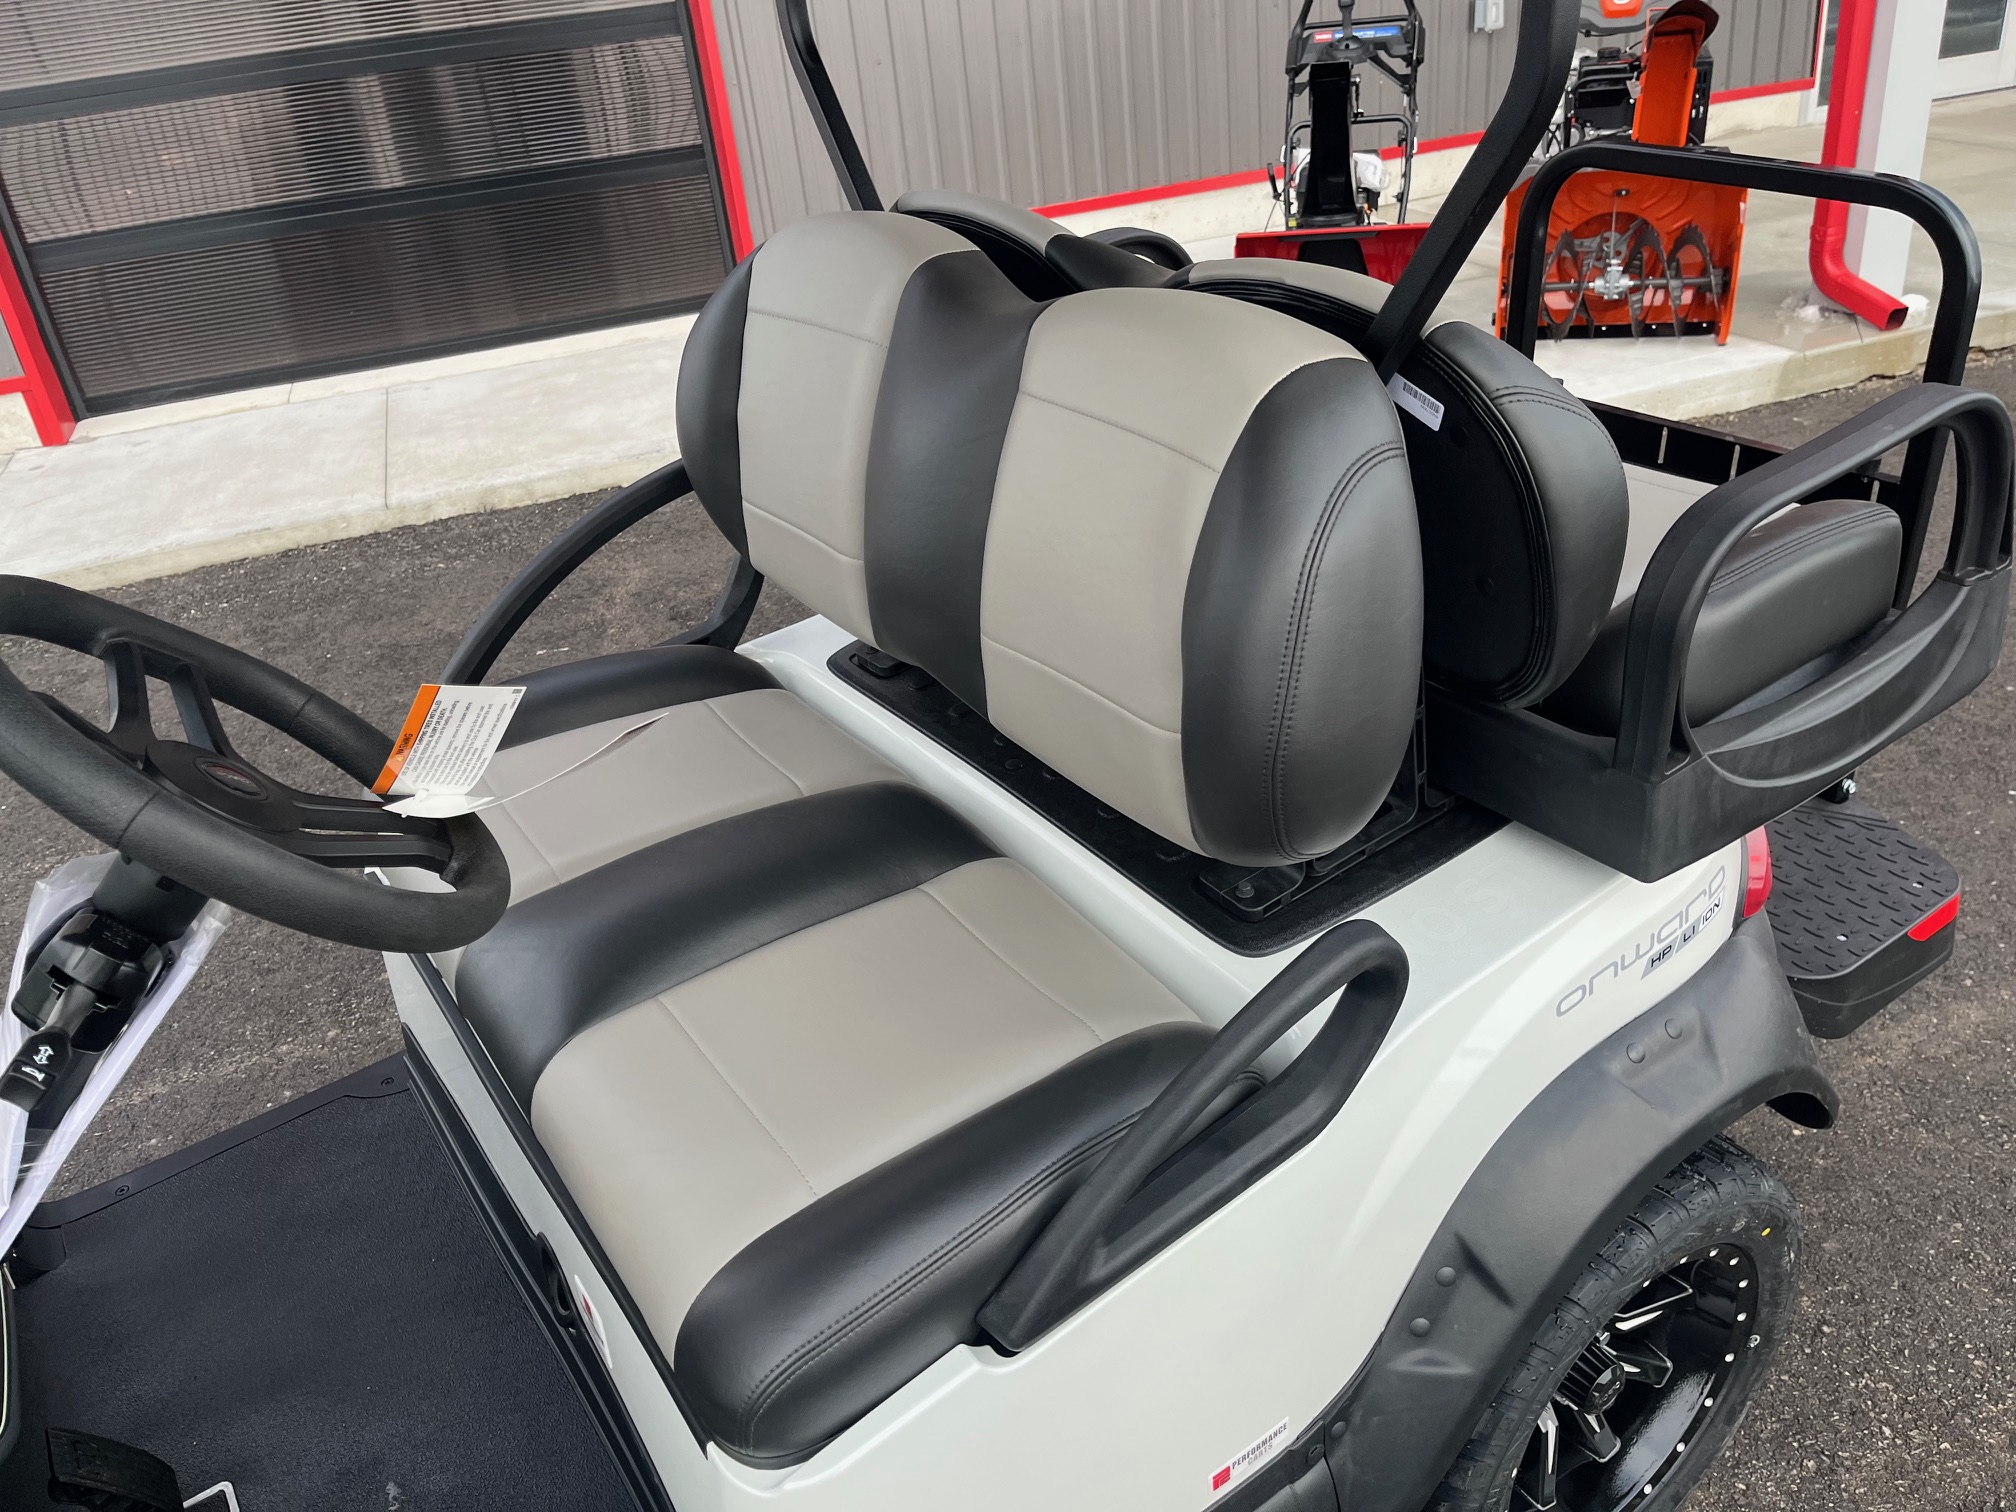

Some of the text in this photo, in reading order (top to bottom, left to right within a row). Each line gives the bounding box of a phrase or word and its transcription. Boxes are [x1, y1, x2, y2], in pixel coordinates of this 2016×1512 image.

[428, 700, 442, 719] INSTALLED
[424, 720, 433, 729] TIRES
[428, 726, 439, 737] INJURY
[396, 733, 413, 755] WARNING
[416, 730, 428, 744] SHIPPING
[1650, 897, 1721, 968] HP LI ION
[1231, 1422, 1288, 1470] PERFORMANCE CARTS
